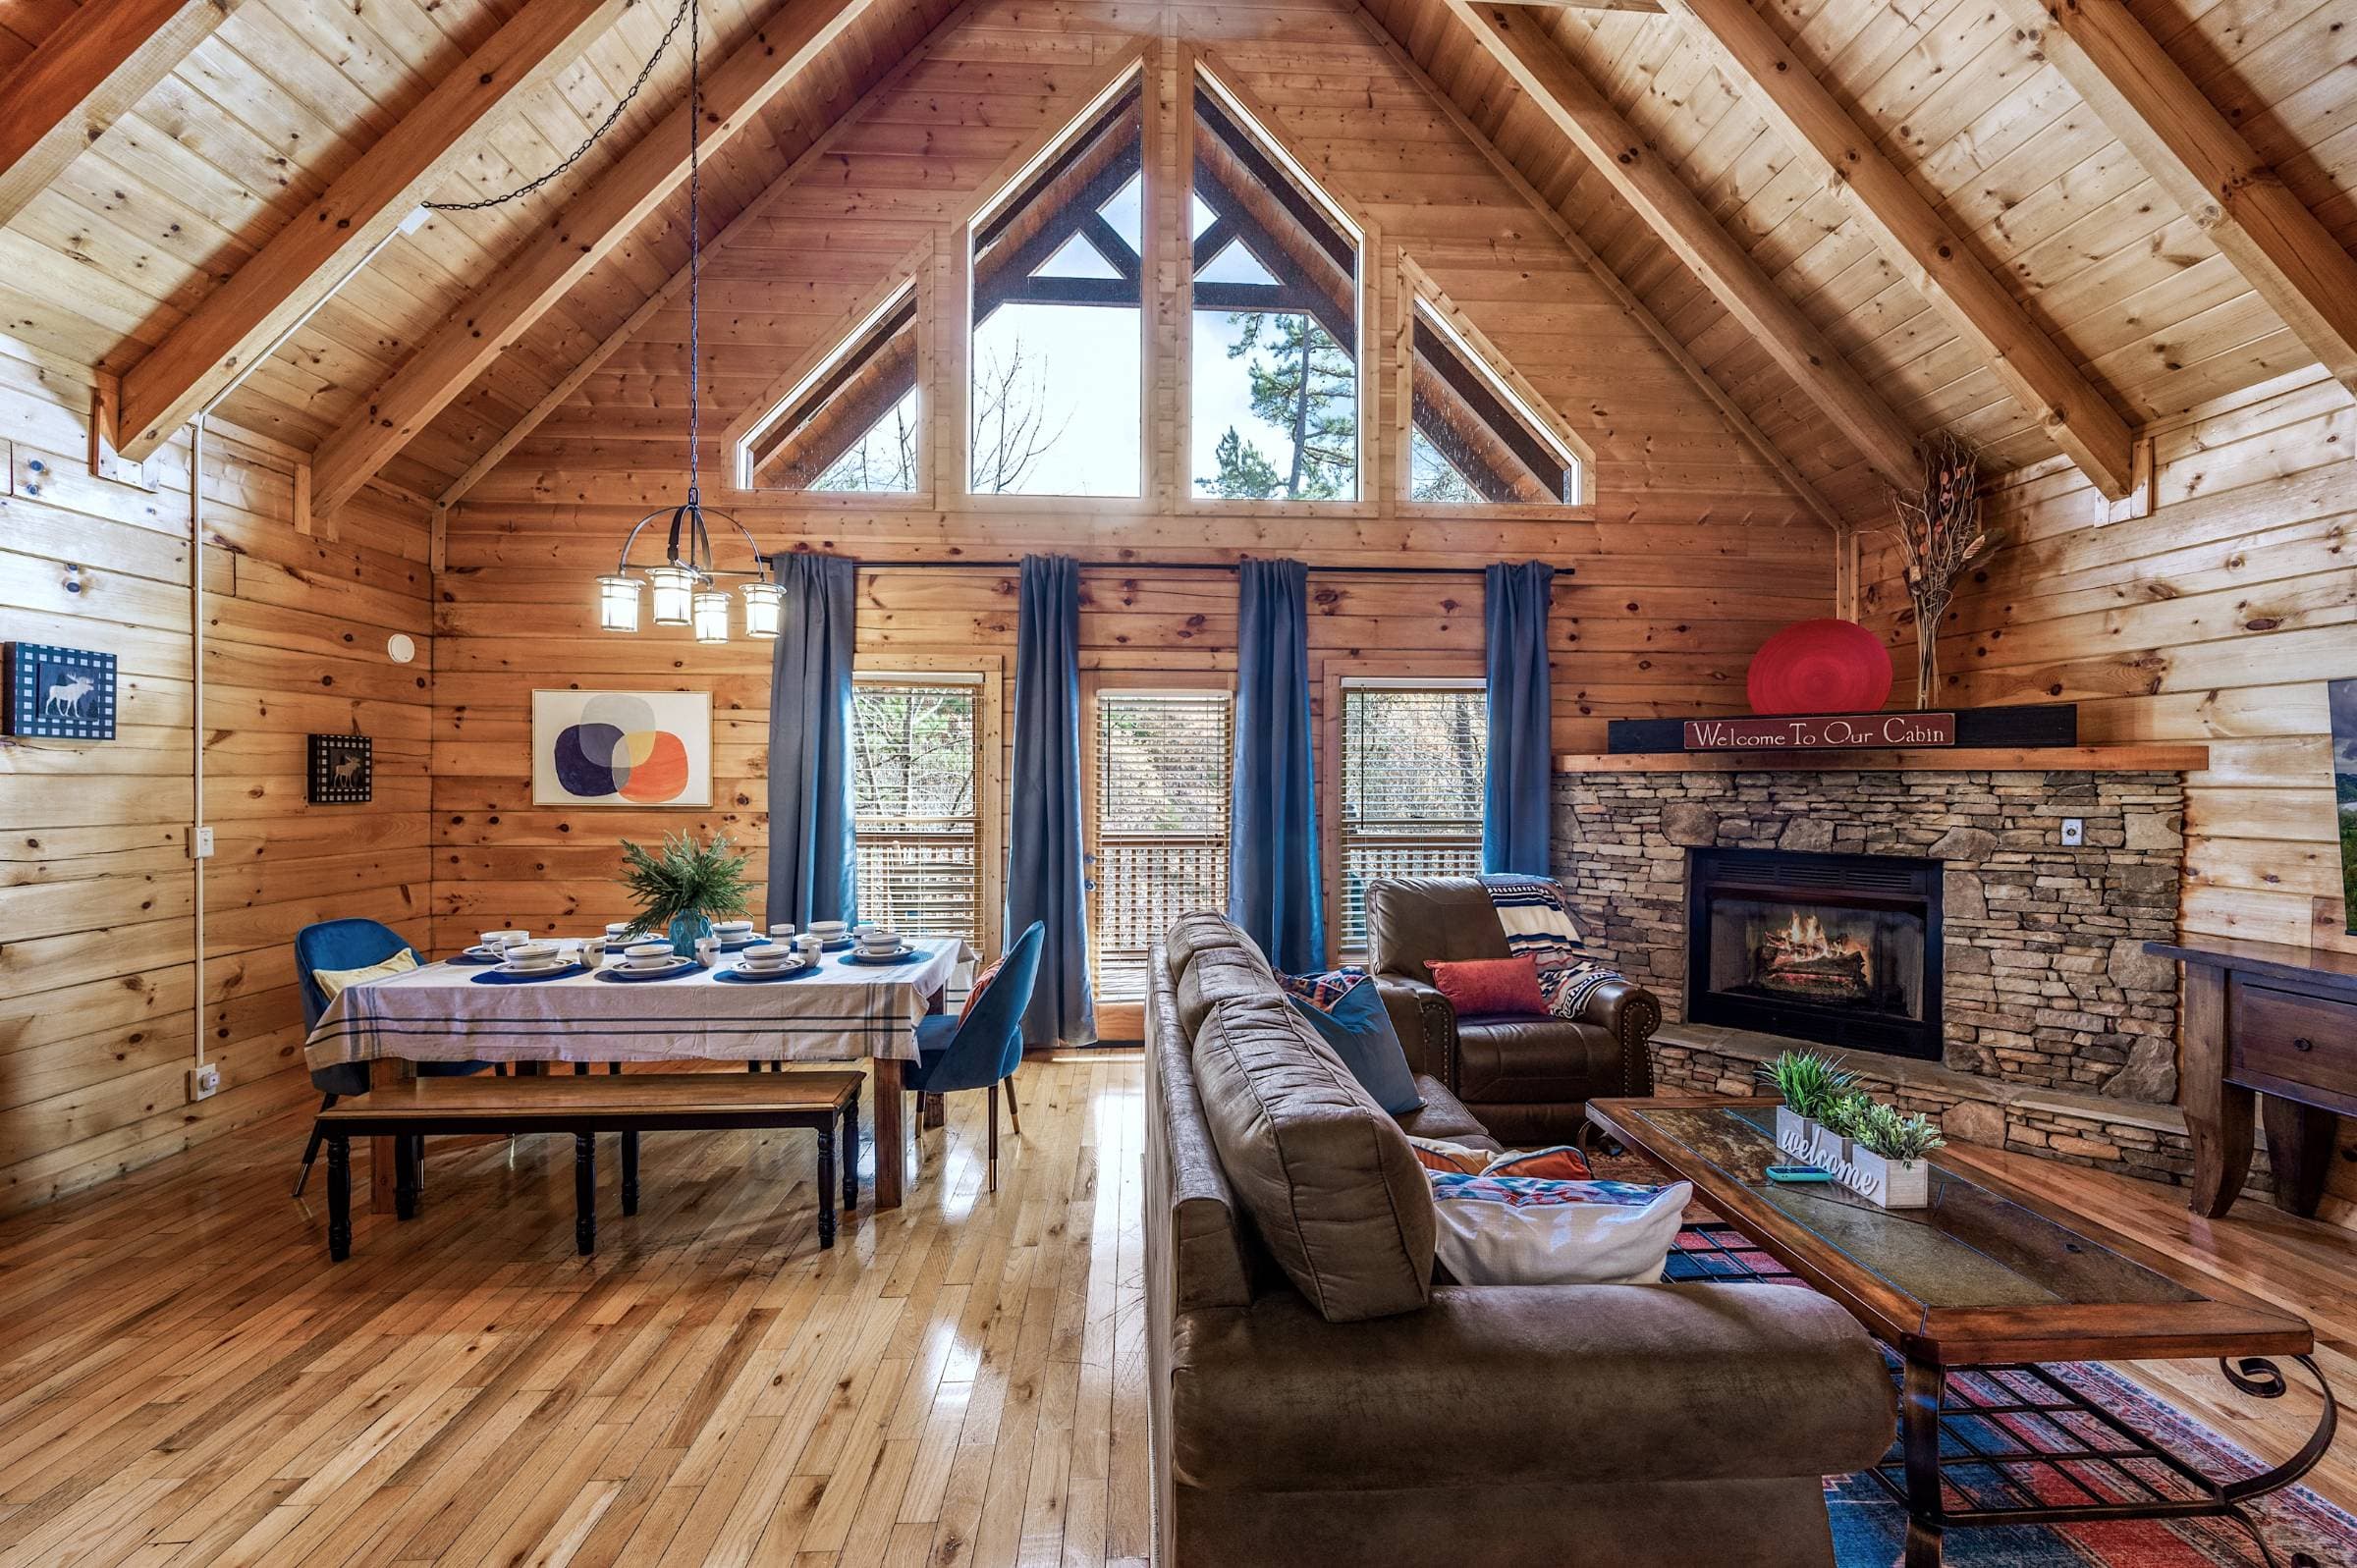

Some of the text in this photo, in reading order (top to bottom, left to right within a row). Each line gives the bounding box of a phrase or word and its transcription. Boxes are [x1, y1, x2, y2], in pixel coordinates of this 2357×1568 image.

[1693, 717, 1945, 747] Welcome To Our Cabin
[1781, 1129, 1880, 1196] welcome
